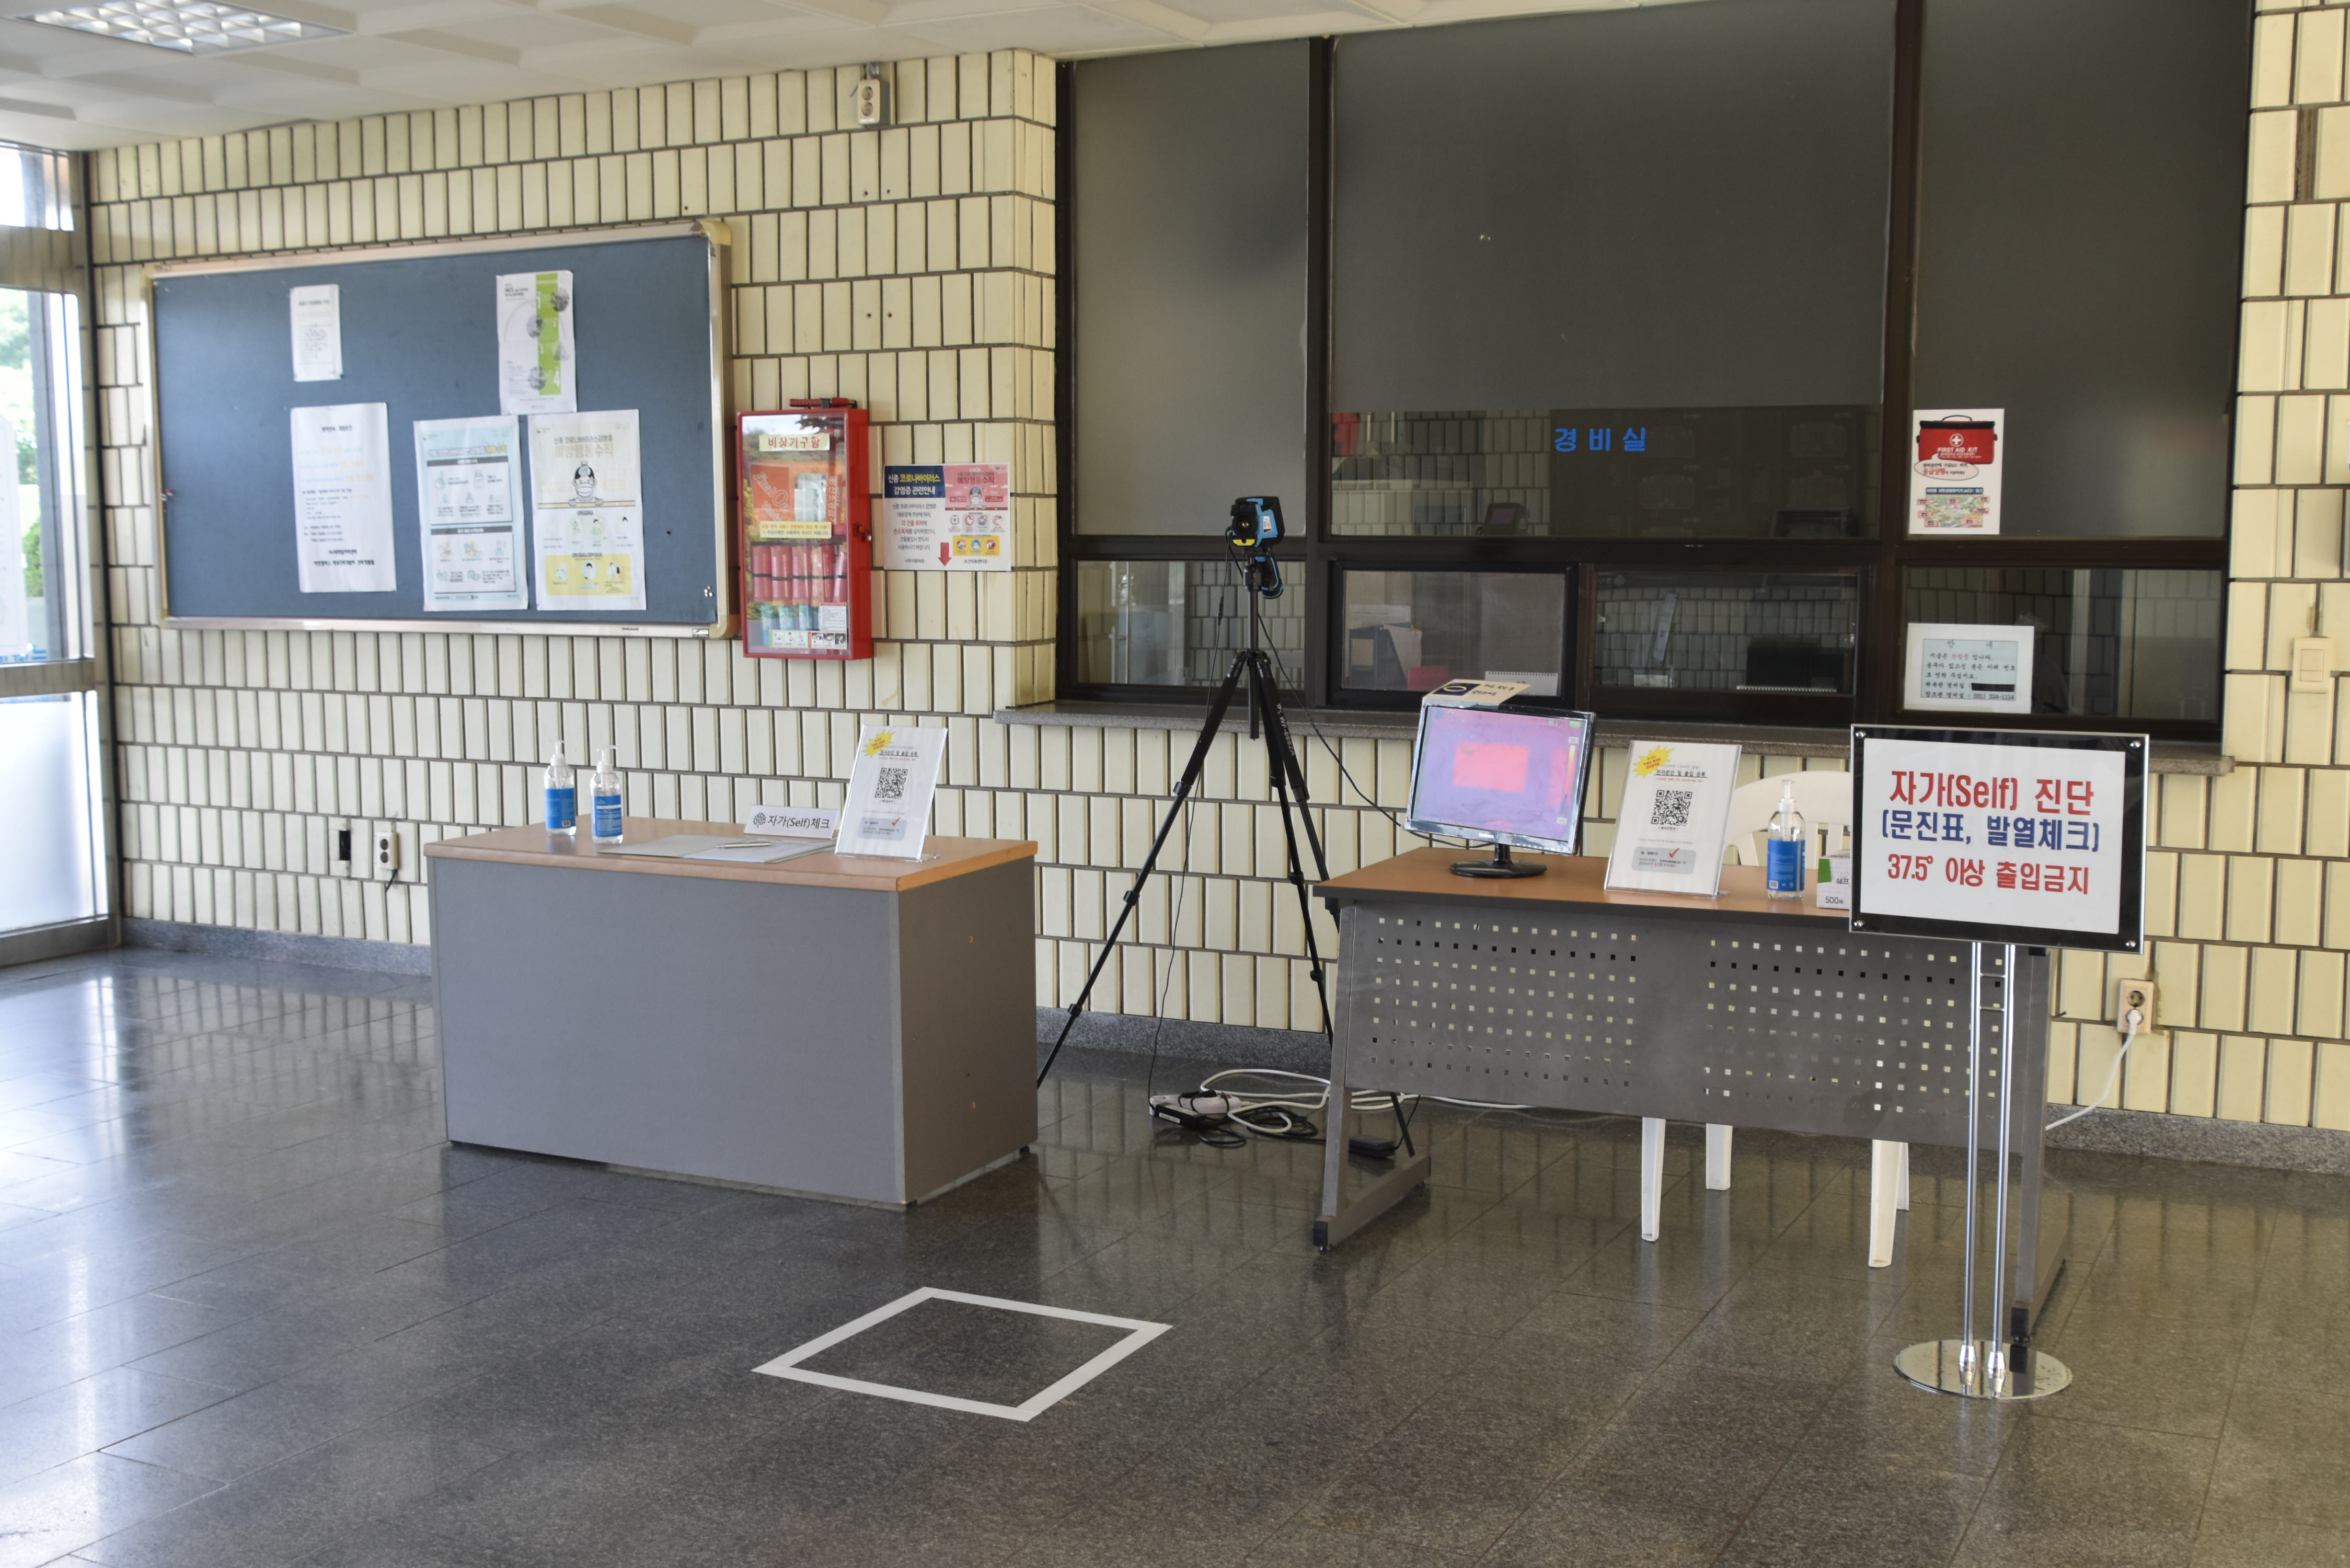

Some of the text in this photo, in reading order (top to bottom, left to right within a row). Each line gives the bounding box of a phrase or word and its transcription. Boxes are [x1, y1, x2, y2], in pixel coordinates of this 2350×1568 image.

[768, 436, 821, 448] 비상기구함
[555, 443, 613, 458] 예방행동수칙
[888, 474, 940, 483] 신종 코로나바이러스
[894, 486, 936, 495] 감염증 관련안내
[2035, 778, 2095, 816] 진단
[767, 815, 830, 829] 자가(Self)체크
[1945, 857, 1986, 887] 이상
[1996, 861, 2089, 895] 출입금지
